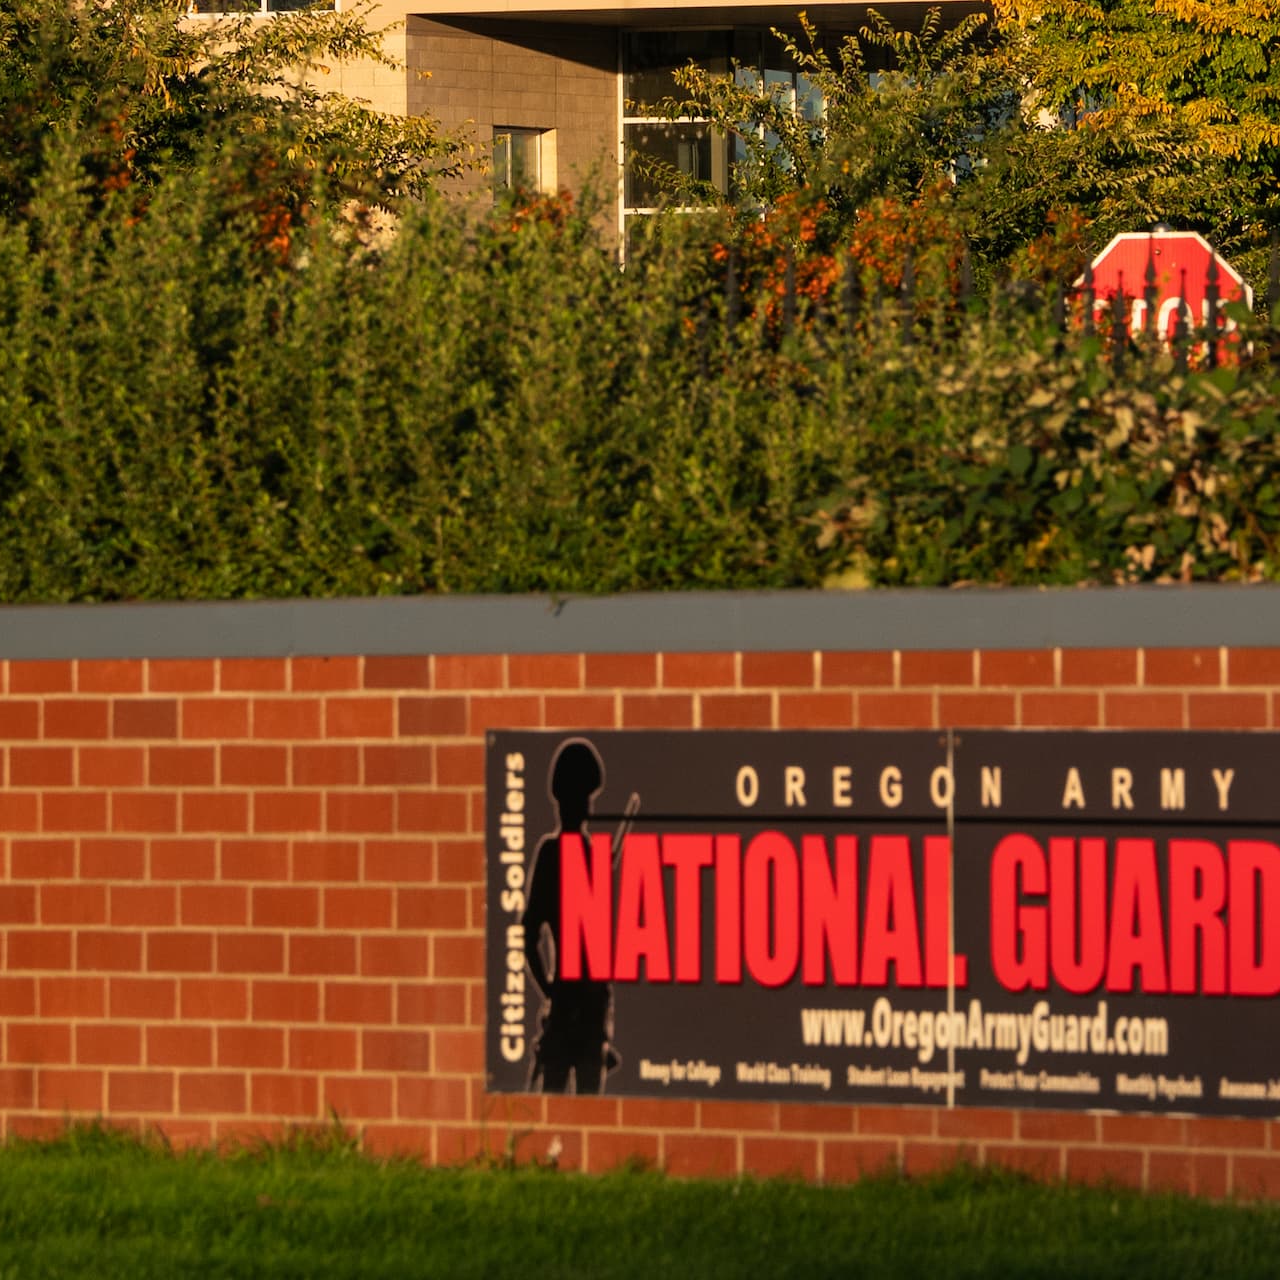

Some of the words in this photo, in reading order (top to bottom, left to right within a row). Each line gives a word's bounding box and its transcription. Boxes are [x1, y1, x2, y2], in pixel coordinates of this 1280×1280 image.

[500, 753, 525, 913] Soldiers
[736, 766, 1002, 808] OREGON
[1063, 768, 1233, 809] ARMY
[559, 832, 967, 987] NATIONAL
[501, 925, 525, 1061] Citizen
[801, 997, 1169, 1065] www.OregonArmyGuard.com
